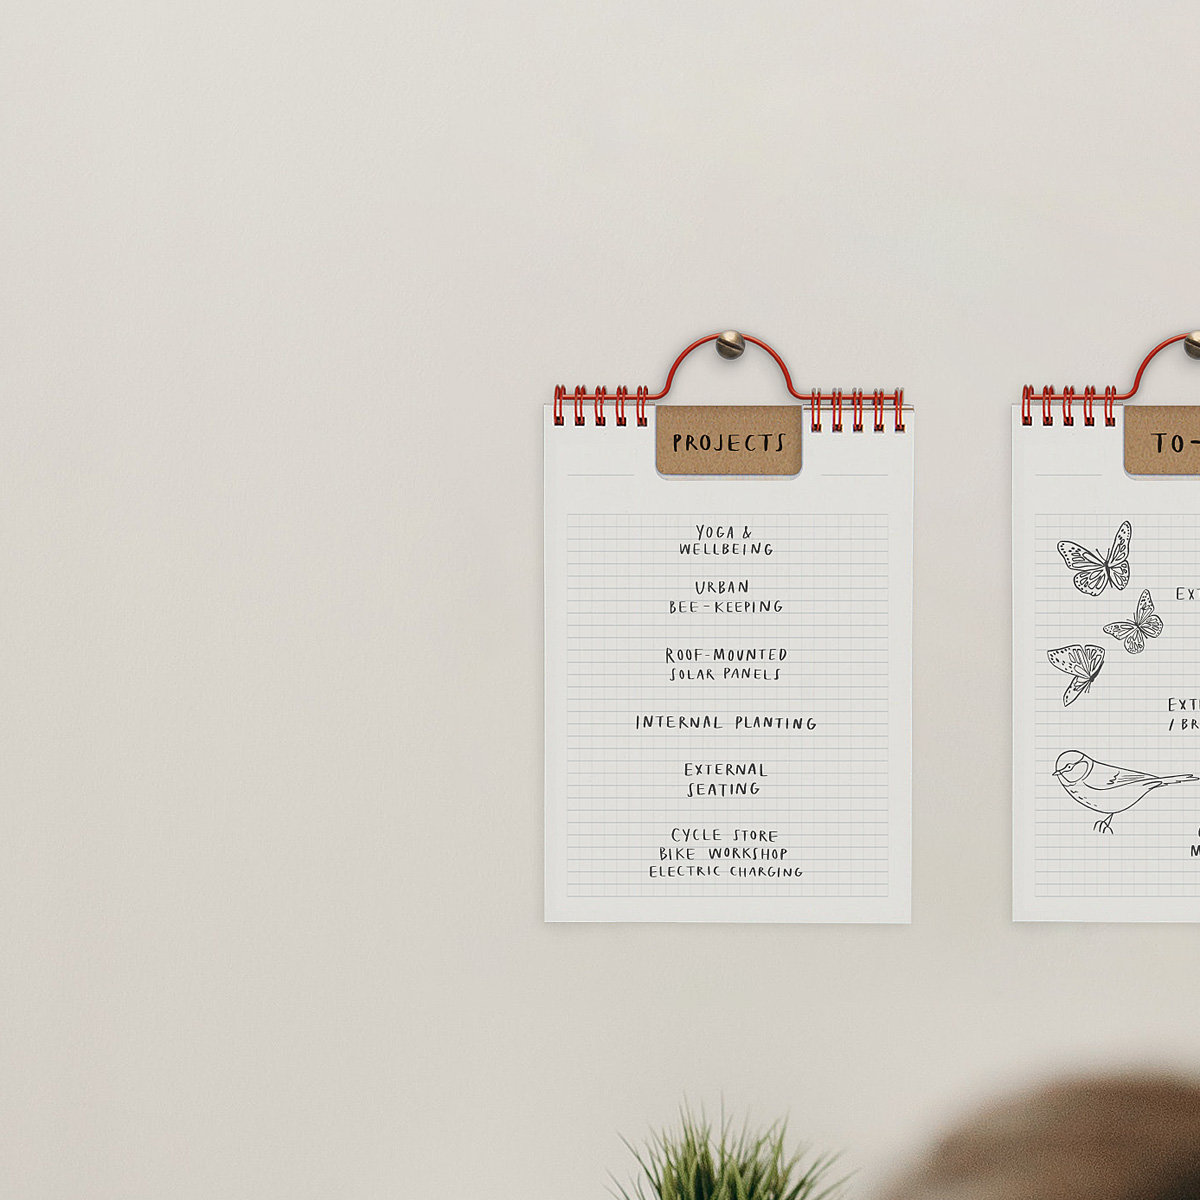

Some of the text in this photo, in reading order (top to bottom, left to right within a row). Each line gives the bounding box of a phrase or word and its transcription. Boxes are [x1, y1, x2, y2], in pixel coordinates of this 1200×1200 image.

[673, 433, 786, 453] PROJECTS
[695, 524, 734, 541] YOGA
[679, 542, 774, 556] WELLBEING
[695, 579, 749, 595] URBAN
[669, 599, 783, 615] BEE-KEEPING
[665, 647, 787, 664] ROOF-MOUNTED
[669, 667, 781, 682] SOLAR PANELS
[636, 715, 817, 731] INTERNAL PLANTING
[684, 762, 768, 777] EXTERNAL
[687, 782, 760, 798] SEATING
[671, 827, 778, 843] CYCLE STORE
[659, 846, 788, 861] BIKE WORKSHOP
[649, 865, 803, 878] ELECTRIC CHARGING
